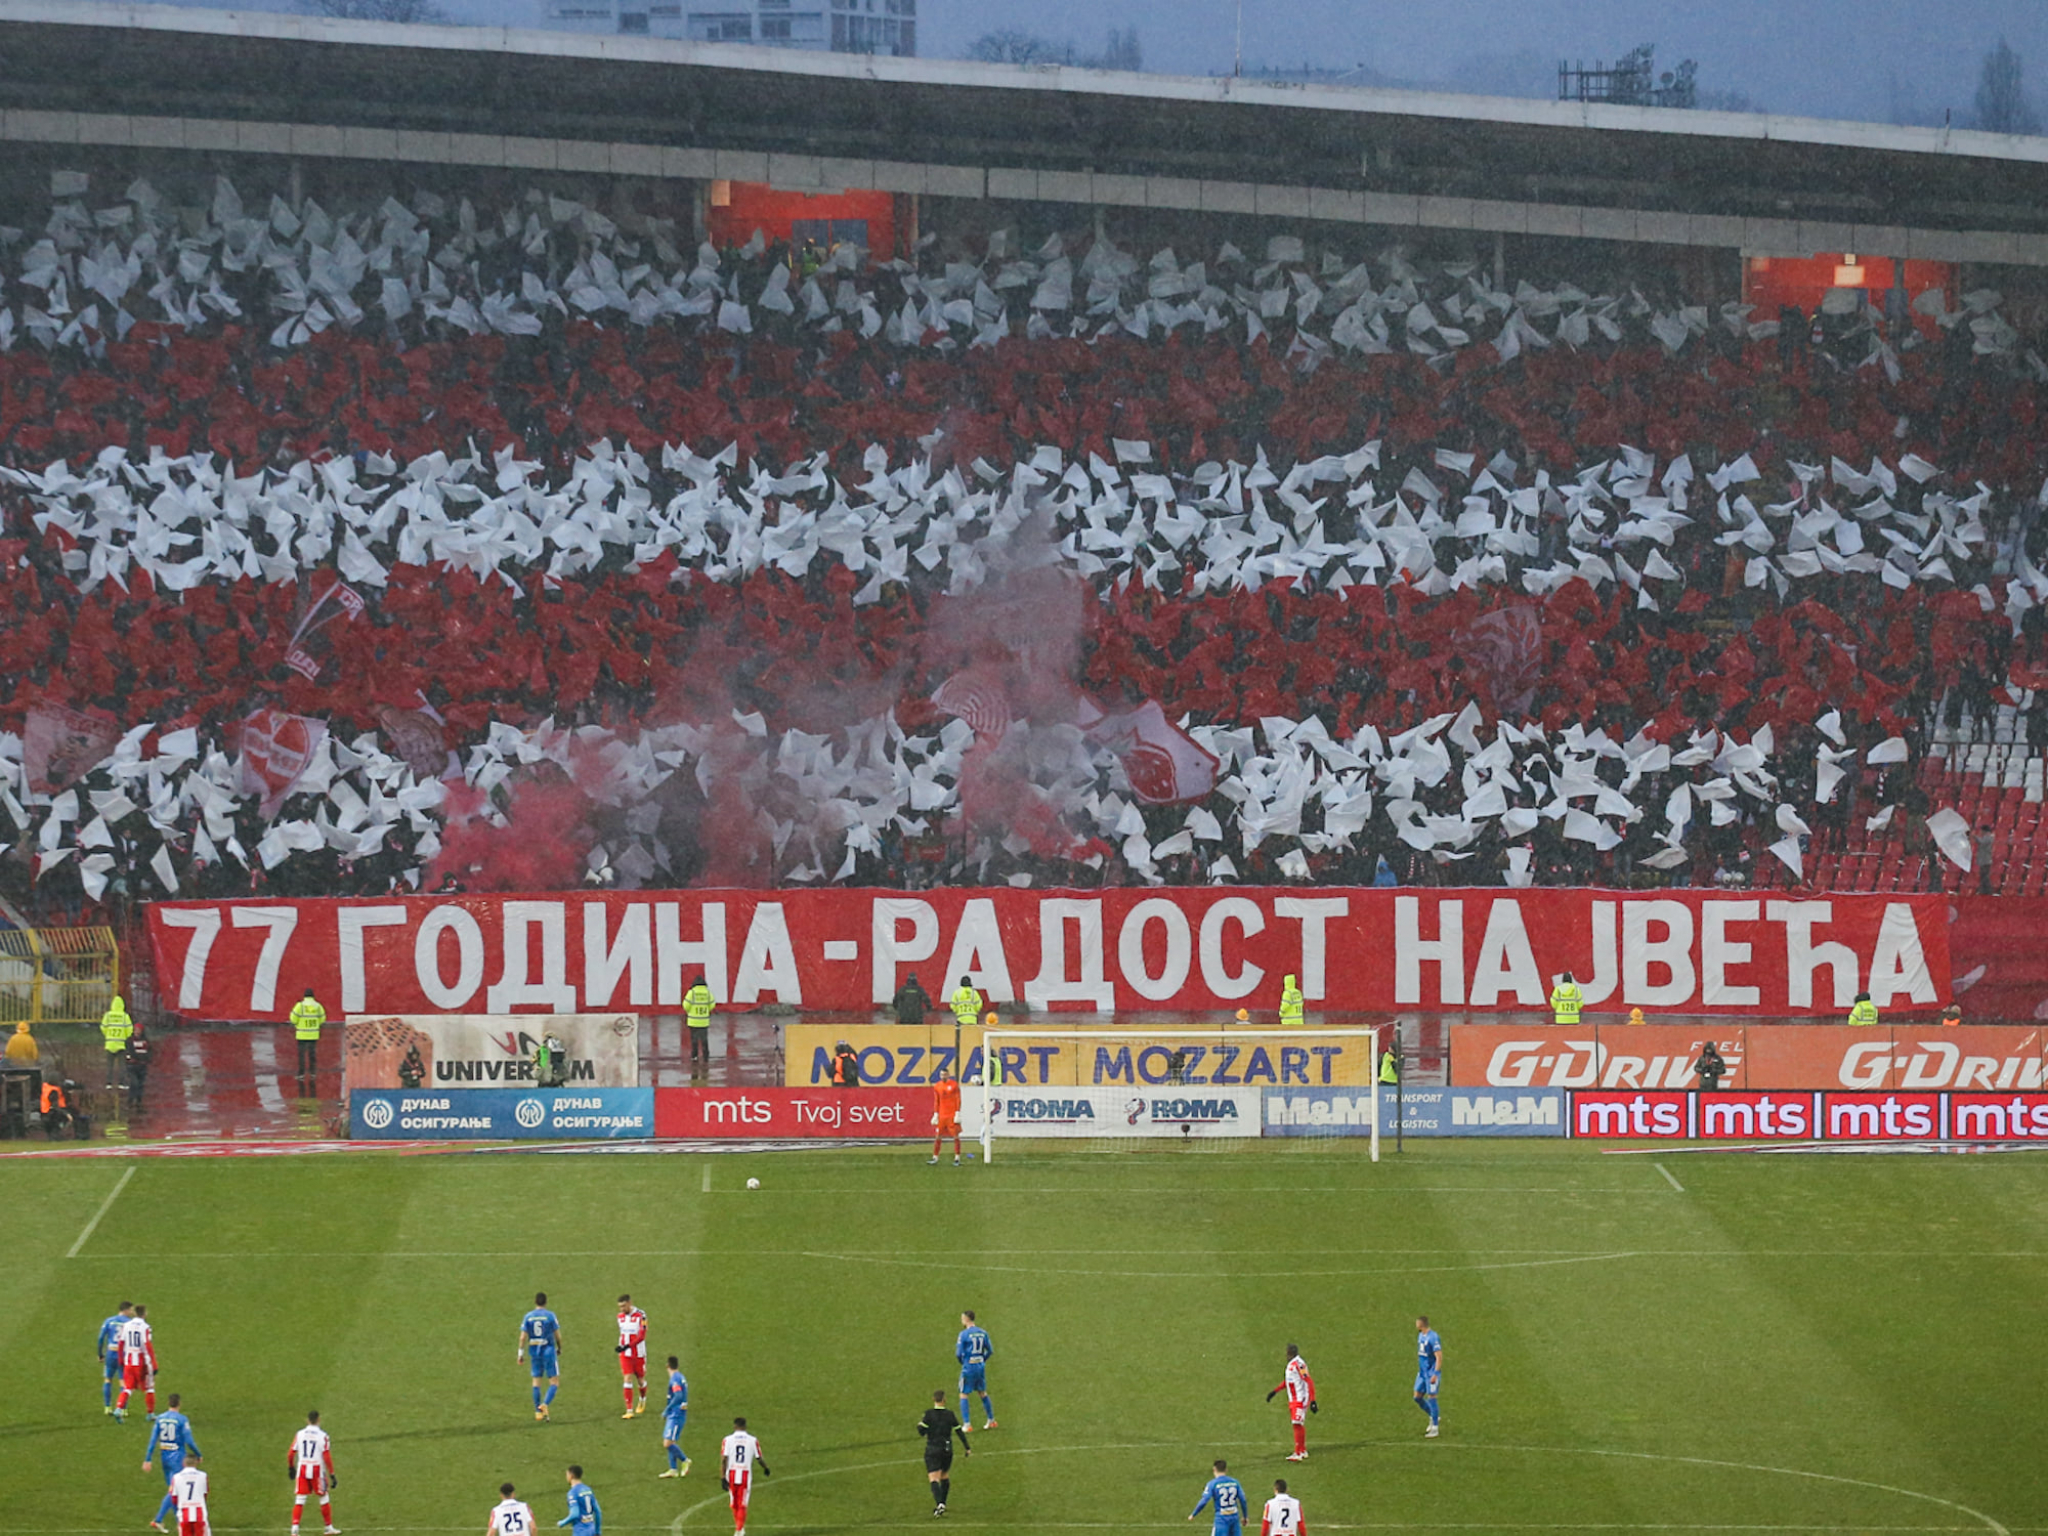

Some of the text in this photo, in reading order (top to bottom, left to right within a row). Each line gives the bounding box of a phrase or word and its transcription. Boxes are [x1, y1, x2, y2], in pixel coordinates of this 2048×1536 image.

[160, 906, 298, 1012] 77
[338, 901, 802, 1014] ГОДИНА
[872, 897, 1349, 1011] РАДОСТ
[1394, 896, 1938, 1007] НАЈВЕЋА
[1690, 1041, 1744, 1052] FEL
[1093, 1046, 1342, 1084] MOZZART
[401, 1099, 450, 1112] ДУНАВ
[552, 1098, 602, 1112] ДУНАВ
[703, 1096, 904, 1128] mts Tvoj svet
[1007, 1099, 1095, 1118] ROMA
[1151, 1099, 1239, 1118] ROMA
[1268, 1096, 1373, 1125] M&M
[1452, 1096, 1559, 1125] M&M
[401, 1117, 491, 1129] ОСИГУРАЊЕ
[552, 1116, 643, 1128] ОСИГУРАЊЕ
[1579, 1096, 1680, 1135] mts
[1705, 1096, 1806, 1136] mts
[1830, 1096, 1932, 1136] mts
[1956, 1097, 2048, 1136] mts
[533, 1320, 543, 1337] 6
[128, 1331, 141, 1347] 10
[160, 1423, 176, 1441] 20
[303, 1440, 316, 1458] 17
[735, 1445, 745, 1463] 8
[186, 1481, 196, 1500] 7
[1219, 1486, 1237, 1507] 22
[503, 1512, 523, 1532] 25
[1281, 1508, 1289, 1527] 2
